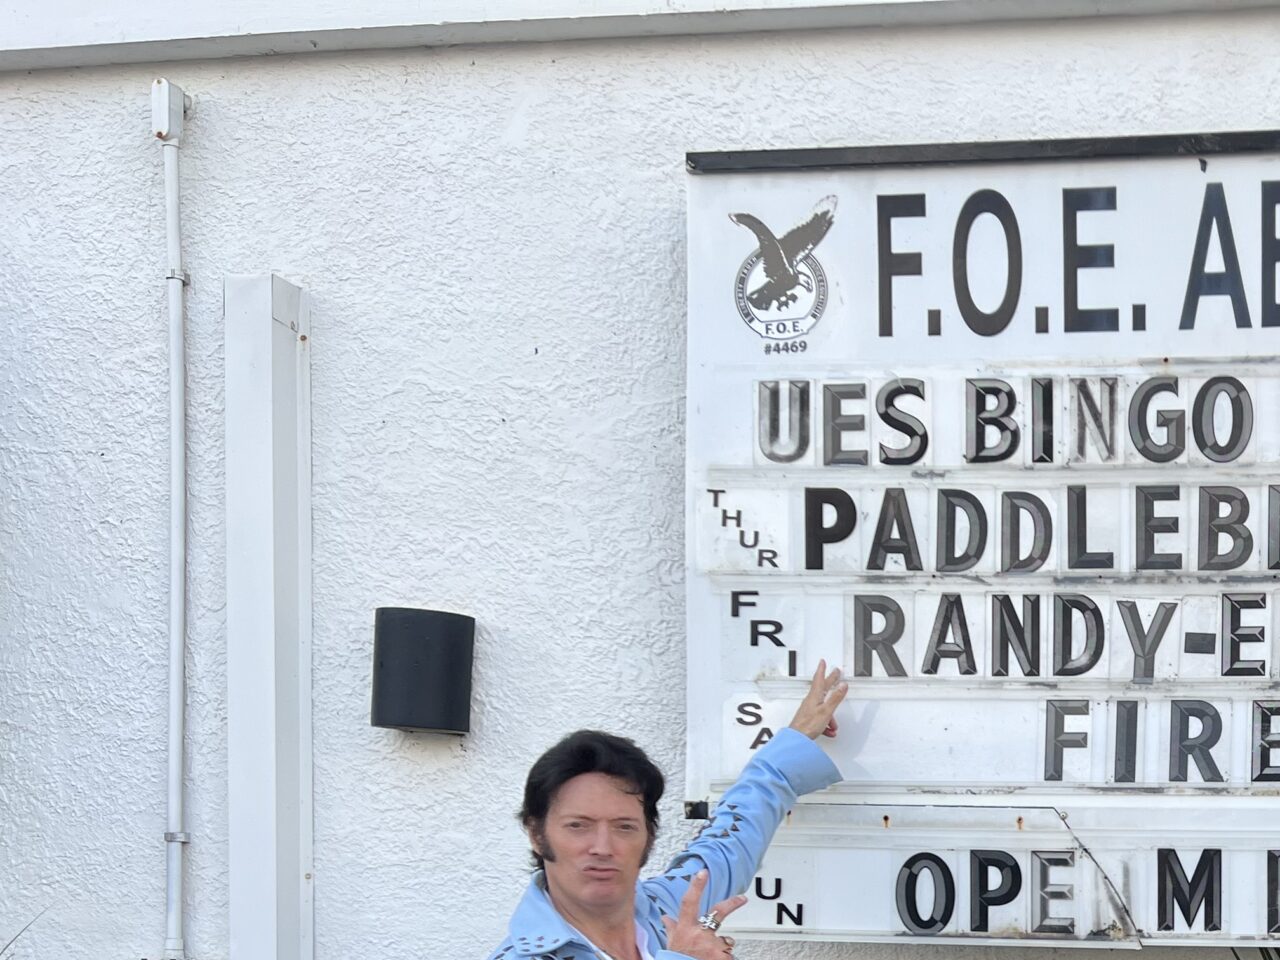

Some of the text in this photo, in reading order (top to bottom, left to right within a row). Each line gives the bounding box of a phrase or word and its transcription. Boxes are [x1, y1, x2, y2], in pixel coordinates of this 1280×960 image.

[876, 187, 1146, 337] F.O.E.
[763, 340, 808, 355] #4469
[764, 321, 804, 335] F.O.E.
[758, 377, 929, 467] UES
[965, 374, 1253, 464] BINGO
[706, 488, 780, 569] THUR
[730, 590, 797, 677] FRI
[735, 702, 775, 751] SA
